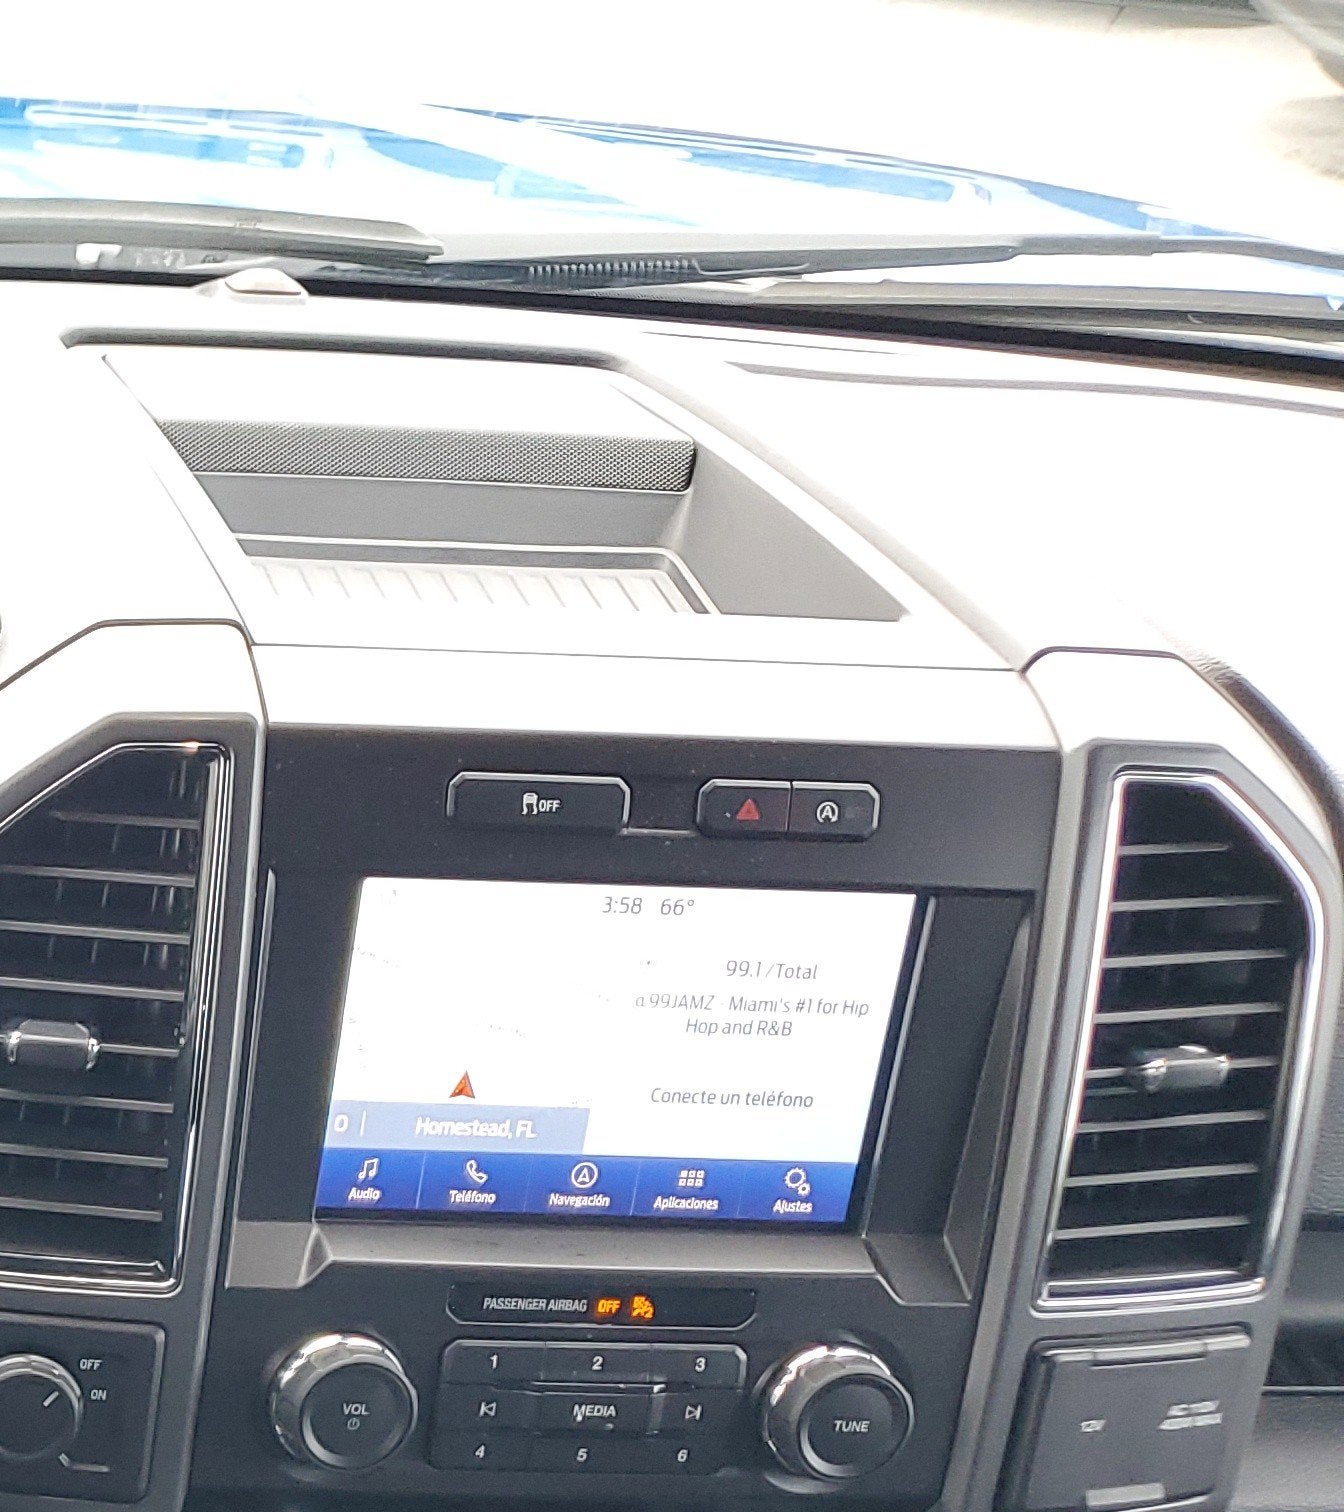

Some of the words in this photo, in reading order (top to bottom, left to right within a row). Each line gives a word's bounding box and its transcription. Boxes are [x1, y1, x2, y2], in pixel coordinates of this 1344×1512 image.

[539, 800, 561, 812] OFF
[602, 896, 643, 914] 3:58
[728, 996, 791, 1013] Miami's
[795, 998, 813, 1014] #1
[816, 999, 838, 1014] for
[842, 1000, 870, 1019] Hip
[685, 1018, 719, 1037] Hop
[722, 1019, 753, 1035] and
[756, 1020, 793, 1037] R&B
[650, 1087, 716, 1105] Conecte
[720, 1092, 741, 1105] un
[745, 1089, 814, 1108] teléfono
[515, 1119, 538, 1140] FL
[348, 1186, 381, 1201] Audio
[449, 1189, 497, 1205] Teléfono
[548, 1192, 611, 1209] Navegación
[653, 1195, 719, 1211] Aplicaciones
[772, 1197, 813, 1214] Ajustes
[483, 1296, 547, 1312] PASSENGER
[548, 1298, 587, 1313] AIRBAG
[597, 1299, 621, 1314] OFF
[80, 1358, 102, 1371] OFF
[489, 1354, 500, 1369] 1
[591, 1355, 604, 1371] 2
[694, 1357, 707, 1372] 3
[90, 1389, 107, 1401] ON
[342, 1402, 370, 1416] VOL
[573, 1404, 616, 1417] MEDIA
[834, 1420, 870, 1433] TUNE
[475, 1443, 486, 1459] 4
[576, 1447, 588, 1462] 5
[677, 1449, 689, 1463] 6
